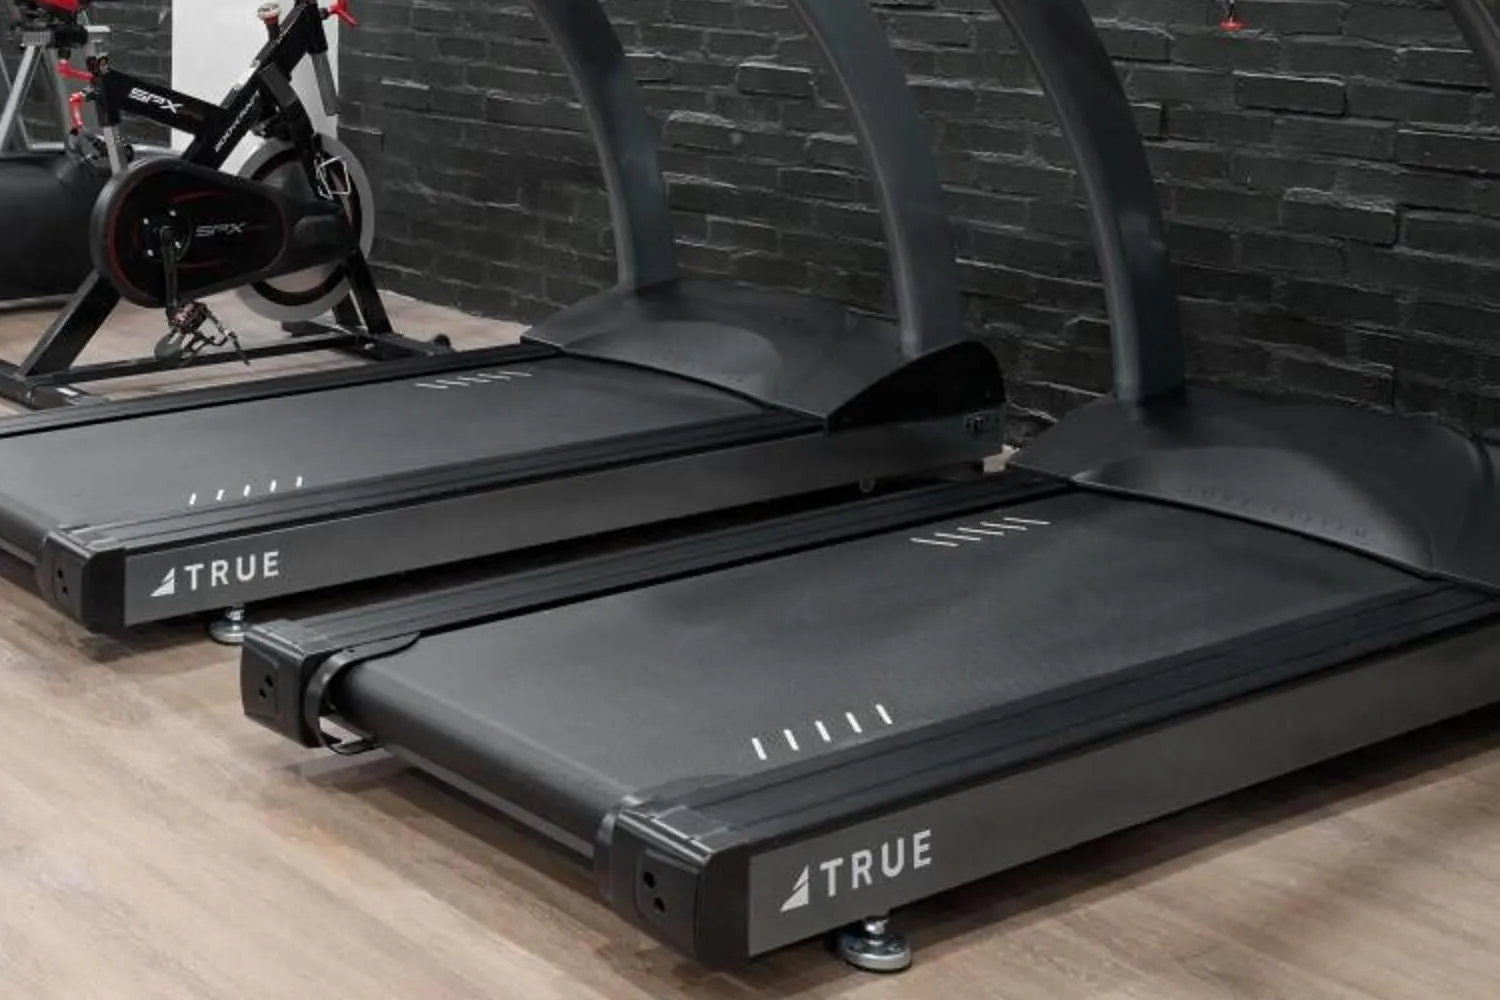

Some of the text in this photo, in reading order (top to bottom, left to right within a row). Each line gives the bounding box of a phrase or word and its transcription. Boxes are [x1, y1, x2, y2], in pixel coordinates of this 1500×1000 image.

[128, 87, 184, 115] SPX
[184, 551, 280, 591] TRUE
[819, 829, 933, 898] TRUE
